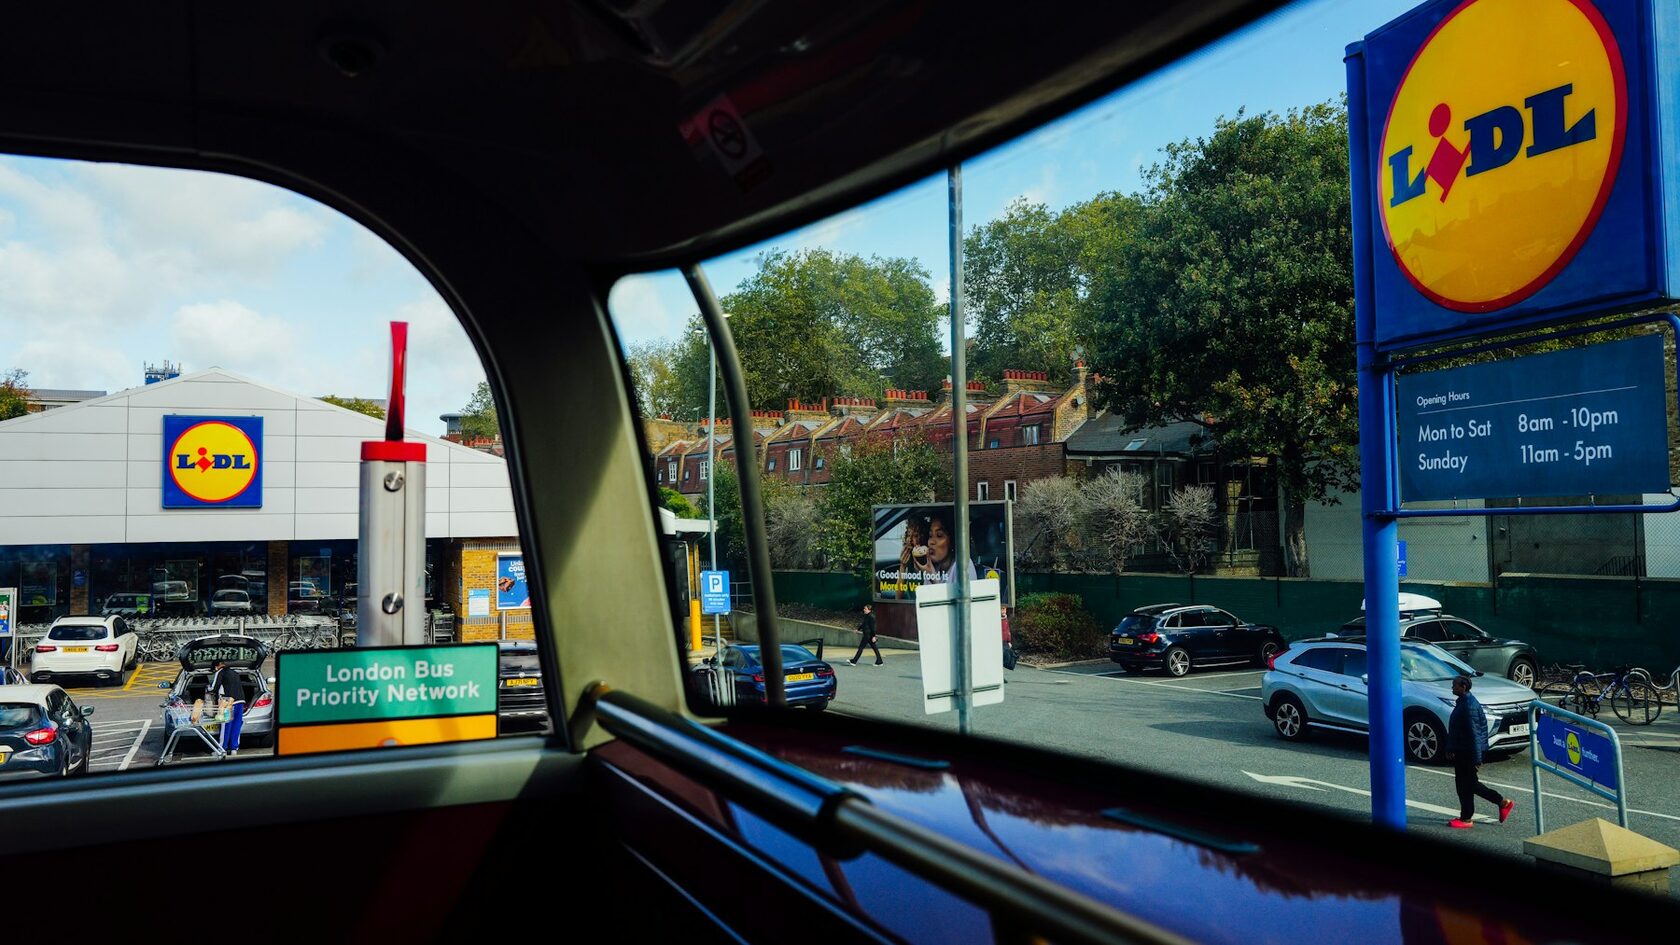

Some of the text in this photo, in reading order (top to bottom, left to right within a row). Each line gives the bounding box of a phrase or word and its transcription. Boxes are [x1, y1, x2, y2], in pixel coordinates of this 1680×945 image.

[1416, 392, 1470, 408] Opening Hours
[1418, 420, 1492, 443] Mon to Sat
[1518, 413, 1554, 433] 8am
[1418, 451, 1468, 473] Sunday
[1520, 444, 1559, 464] 11am
[1573, 440, 1612, 466] 5pm
[711, 577, 720, 590] P
[880, 569, 949, 580] Good mood food is
[880, 581, 899, 591] More
[900, 582, 908, 592] to
[326, 660, 454, 683] London Bus
[296, 680, 480, 707] Priority Network
